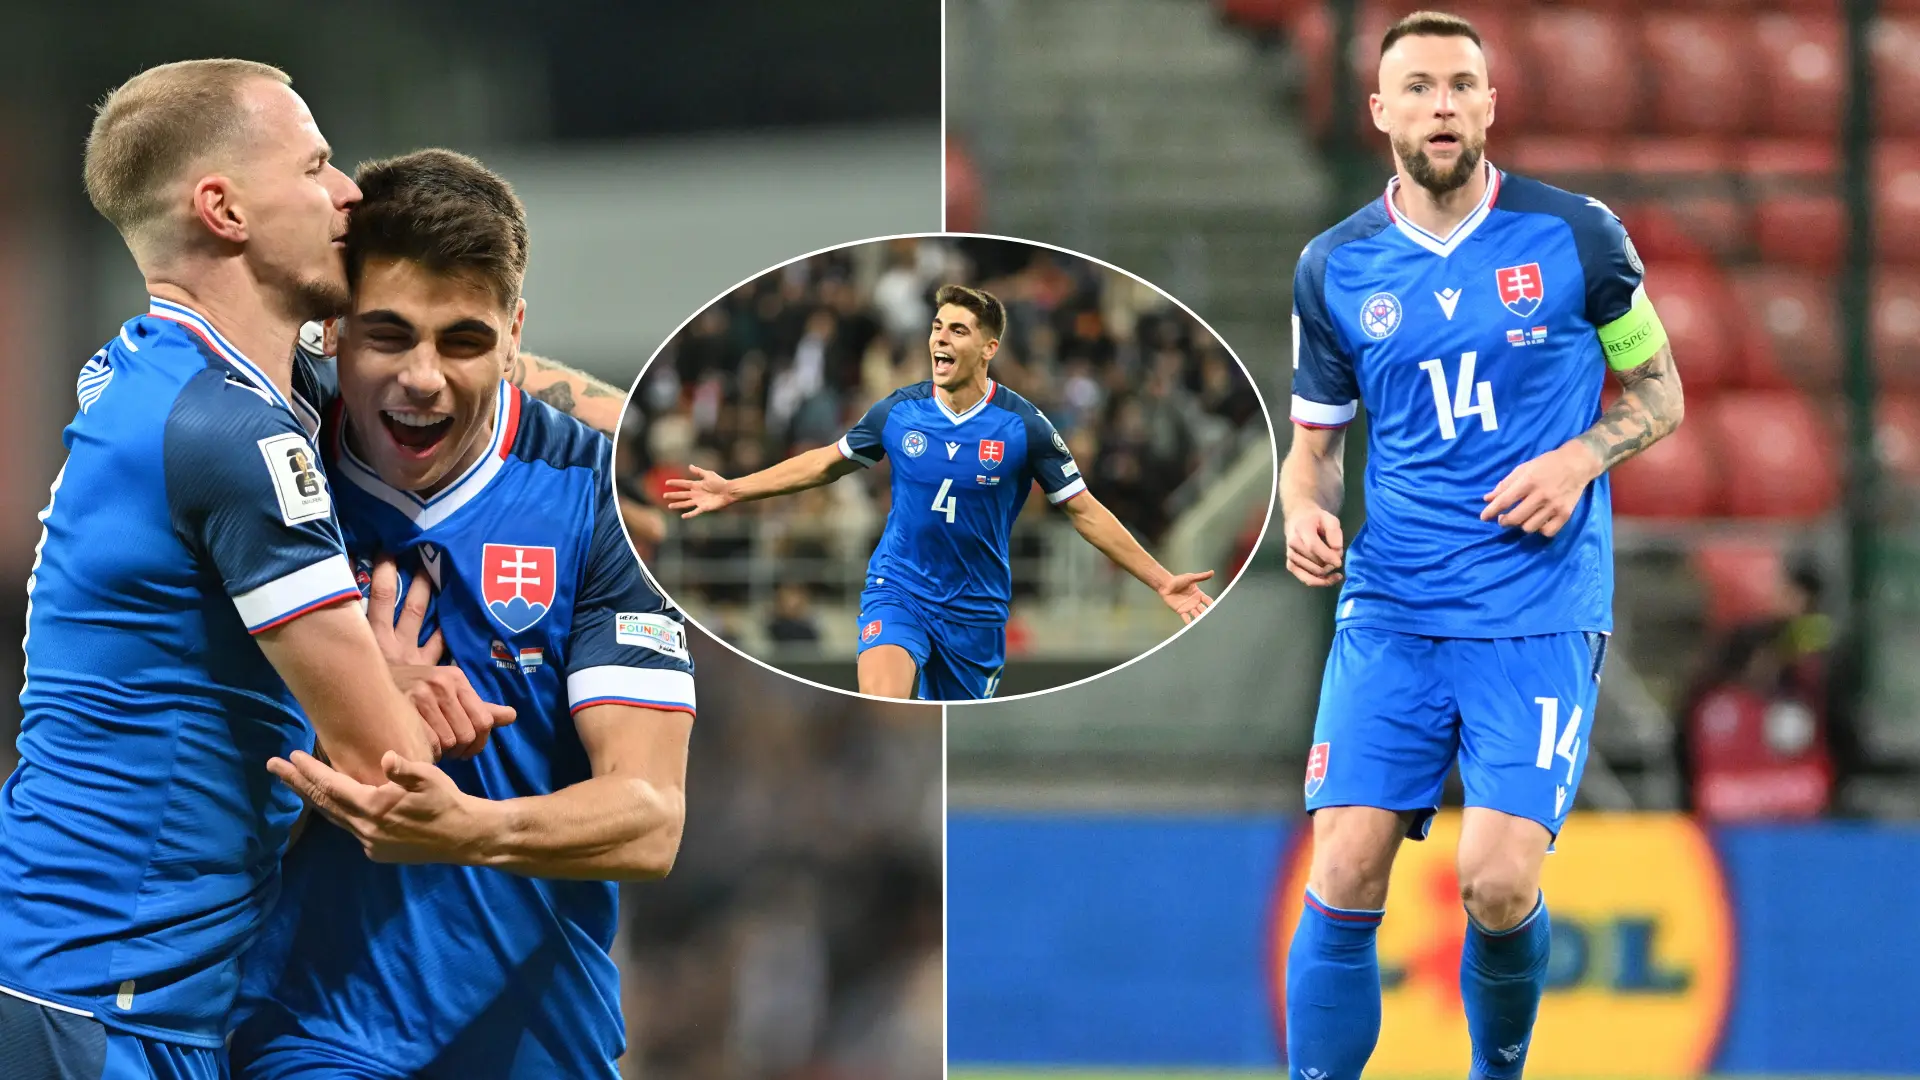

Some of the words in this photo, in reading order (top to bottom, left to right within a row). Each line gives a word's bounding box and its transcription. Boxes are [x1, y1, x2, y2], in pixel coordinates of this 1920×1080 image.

[1607, 322, 1652, 353] RESPECT
[1419, 351, 1498, 440] 14
[930, 478, 957, 523] 4
[1534, 696, 1583, 786] 14
